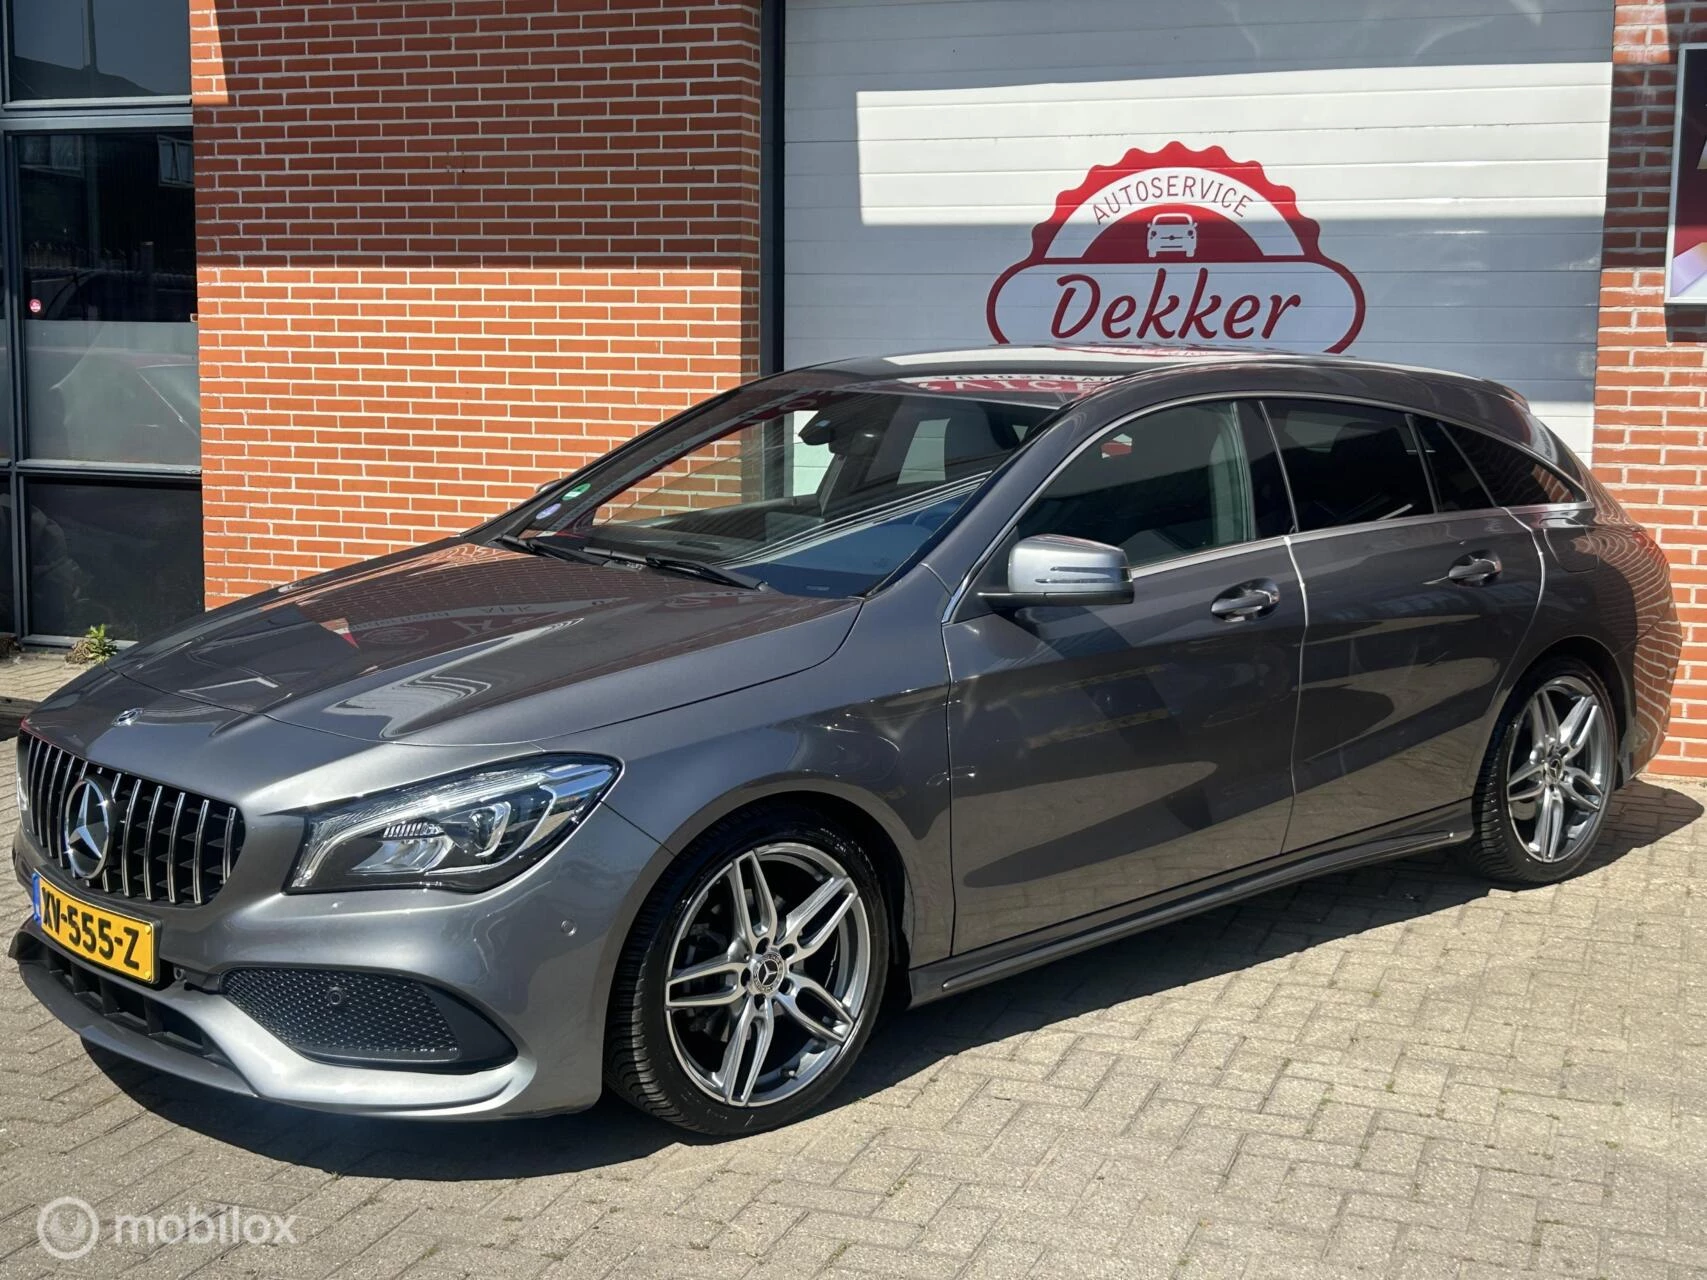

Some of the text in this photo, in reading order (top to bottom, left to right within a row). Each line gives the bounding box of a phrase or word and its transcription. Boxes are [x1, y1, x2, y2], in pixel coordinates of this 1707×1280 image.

[1092, 176, 1253, 225] AUTOSERVICE
[1051, 268, 1301, 339] Dekker
[41, 886, 140, 970] XV-555-Z
